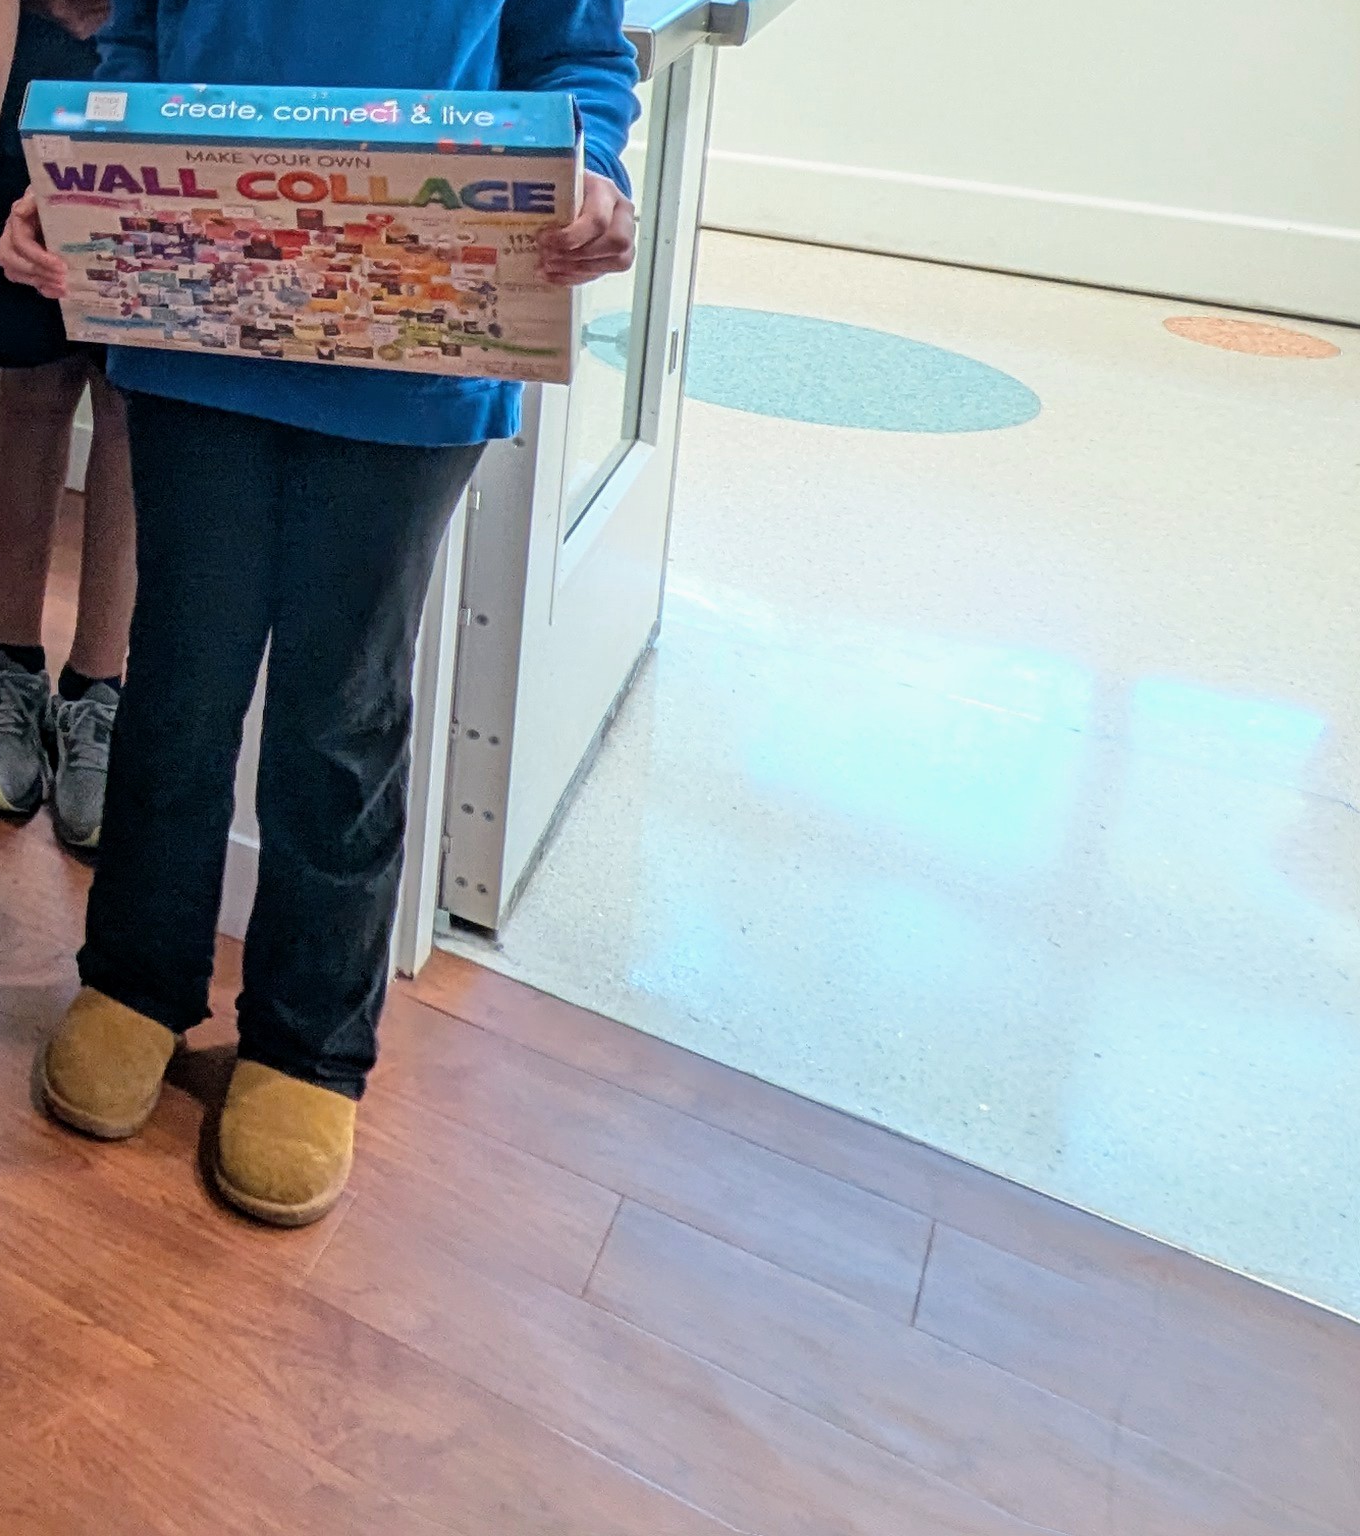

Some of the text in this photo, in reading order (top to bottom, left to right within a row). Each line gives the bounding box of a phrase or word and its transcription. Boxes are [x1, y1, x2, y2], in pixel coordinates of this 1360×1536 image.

[160, 100, 496, 127] create, connect & live
[185, 149, 371, 169] MAKE YOUR OWN
[43, 162, 556, 214] WALL COLLAGE
